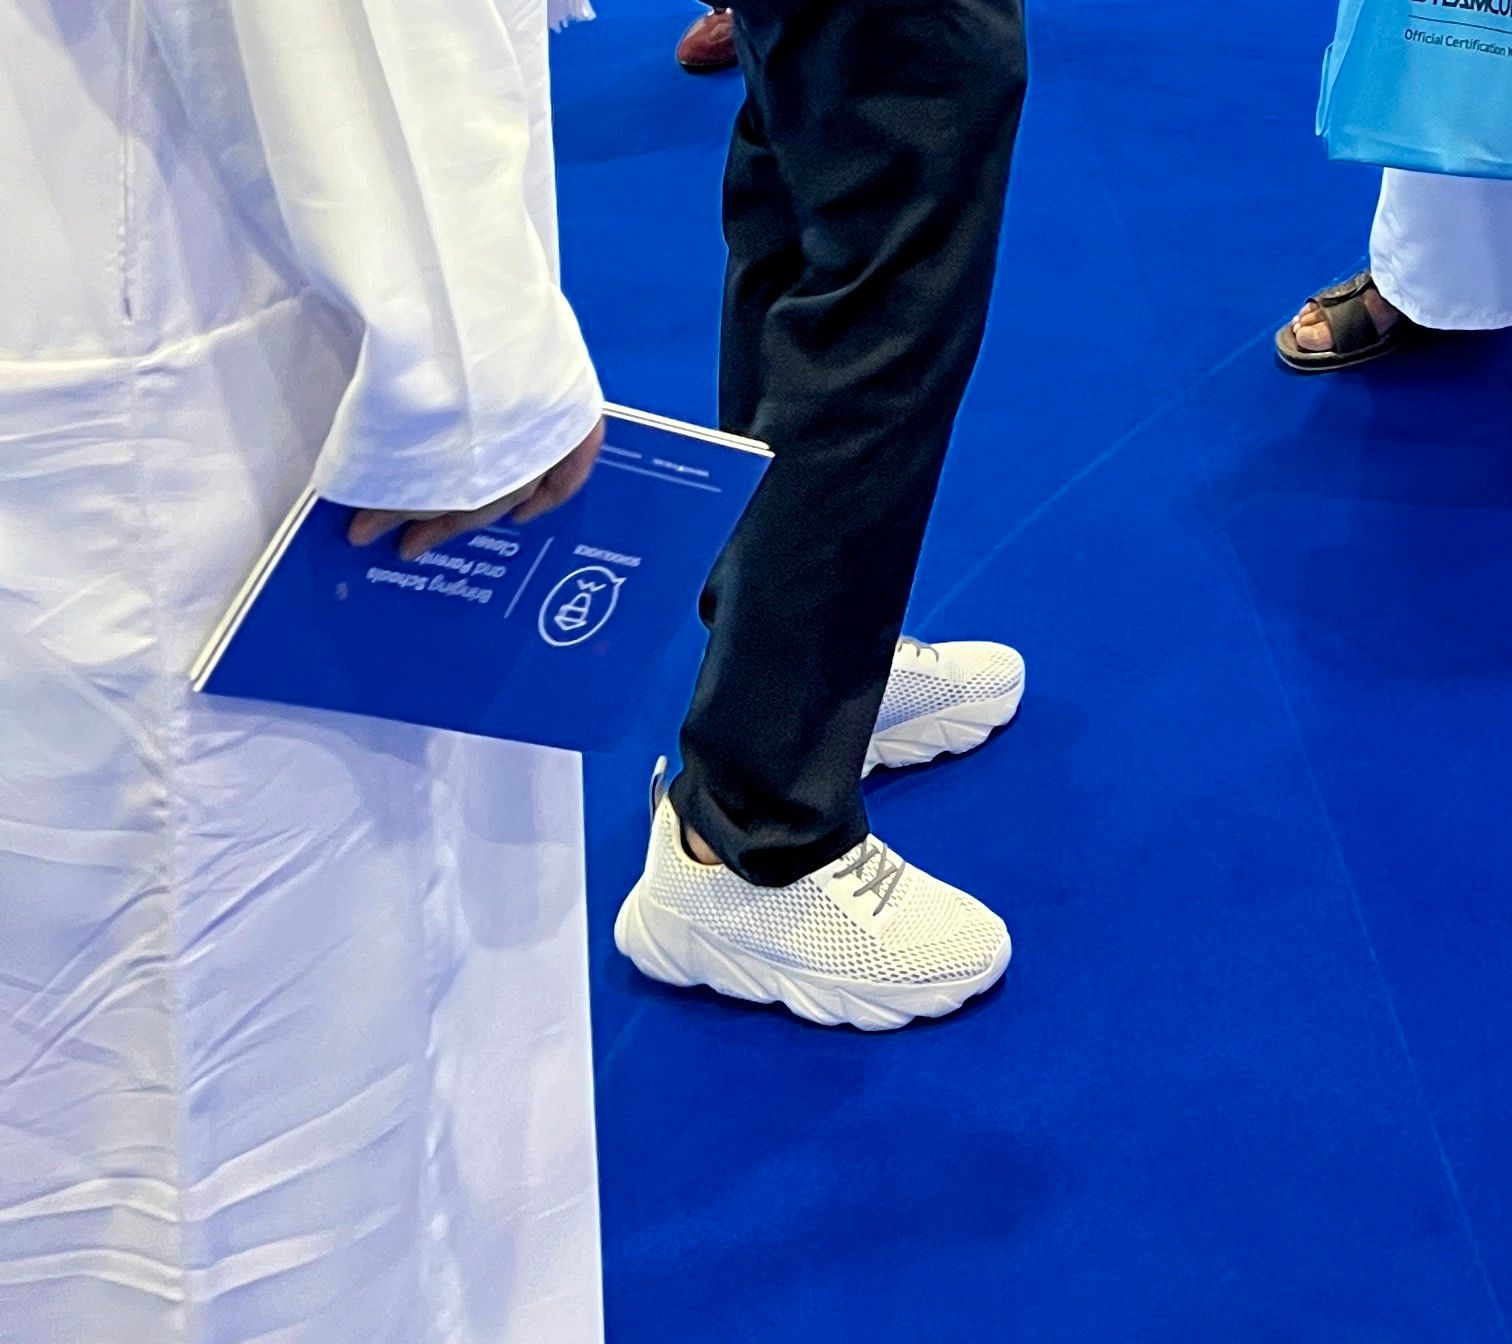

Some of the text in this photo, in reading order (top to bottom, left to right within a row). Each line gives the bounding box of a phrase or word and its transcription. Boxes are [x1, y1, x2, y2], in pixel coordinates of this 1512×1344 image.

[1404, 28, 1445, 46] Official
[1445, 35, 1506, 58] Certification
[467, 534, 520, 557] Closer
[471, 562, 507, 578] and
[366, 567, 493, 604] Bringing Schools
